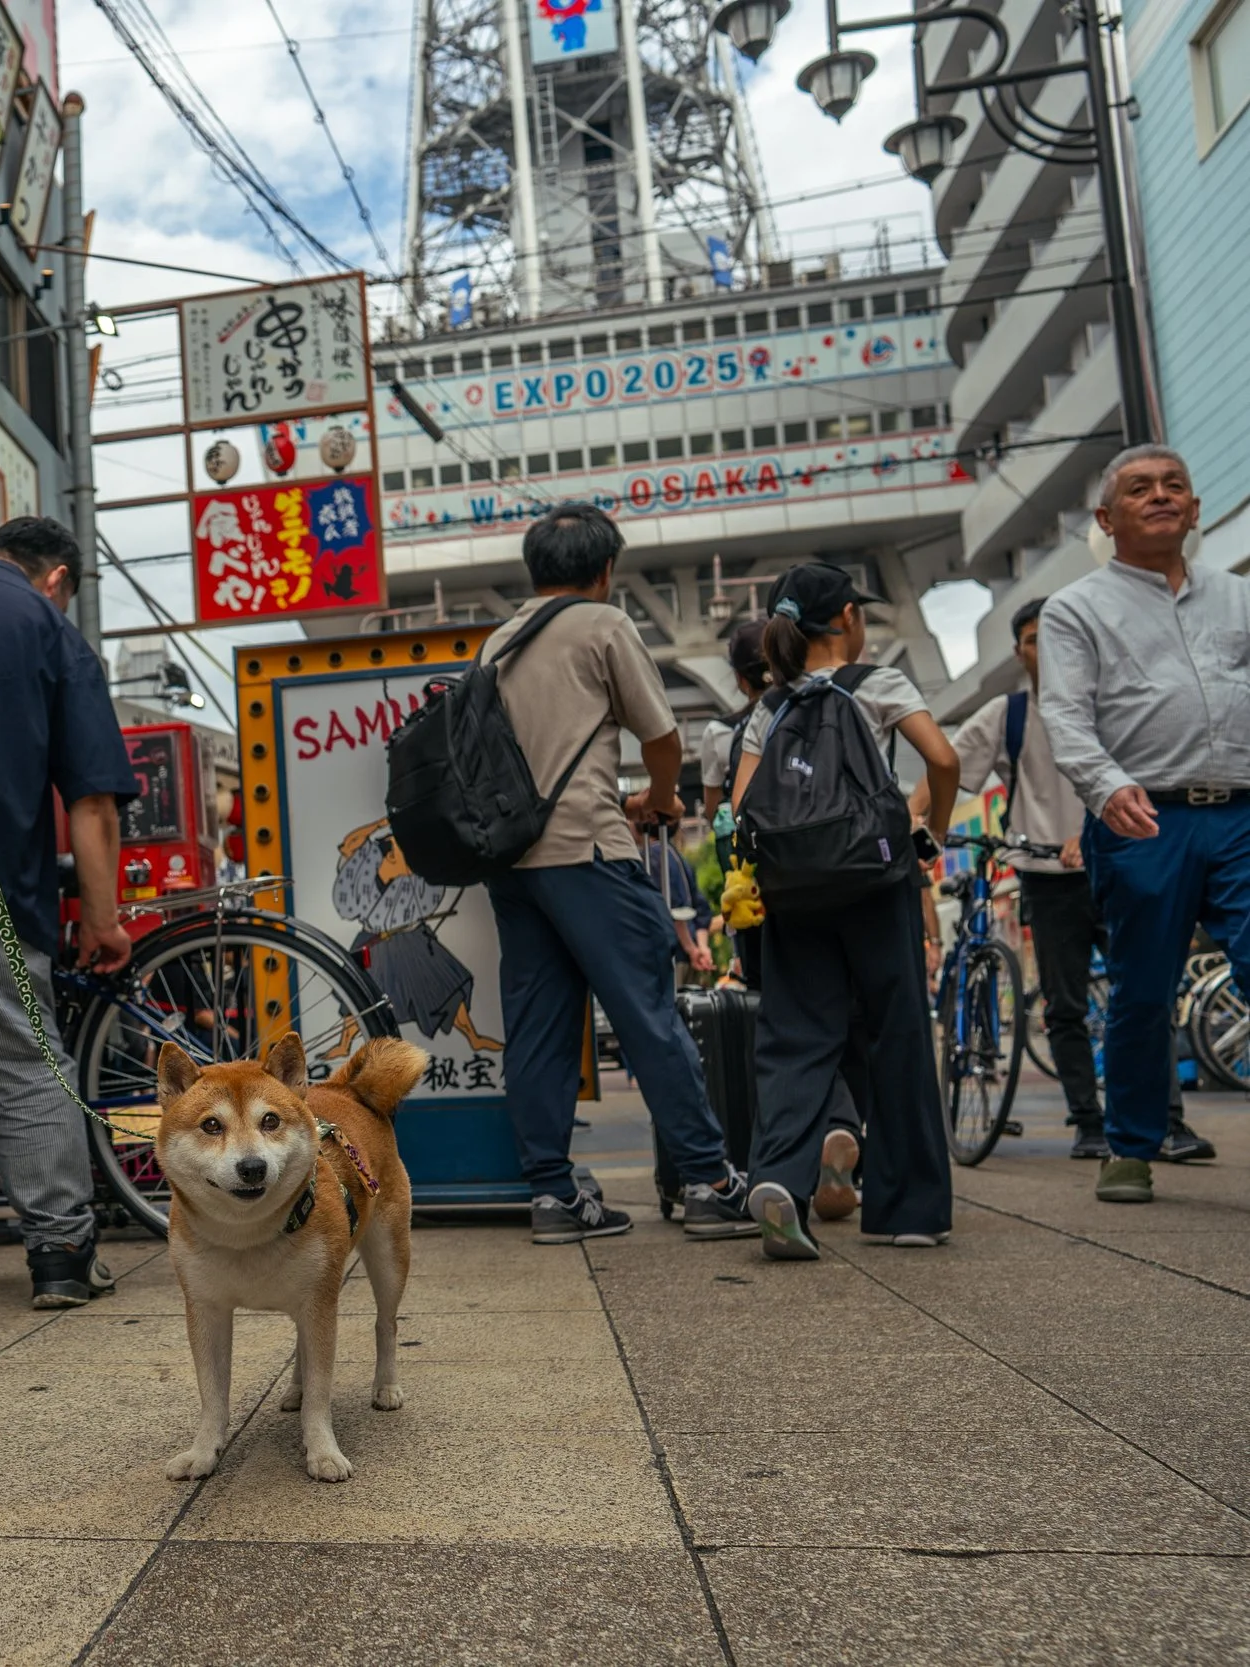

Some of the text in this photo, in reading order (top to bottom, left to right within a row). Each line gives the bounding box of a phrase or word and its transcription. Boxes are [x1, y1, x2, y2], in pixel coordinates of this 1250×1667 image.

[254, 296, 309, 401] 串かつ
[494, 352, 739, 411] EXPO 2025
[630, 463, 781, 508] OSAKA
[241, 494, 281, 580] じゃんじゃん
[422, 1053, 507, 1092] 秘宝
